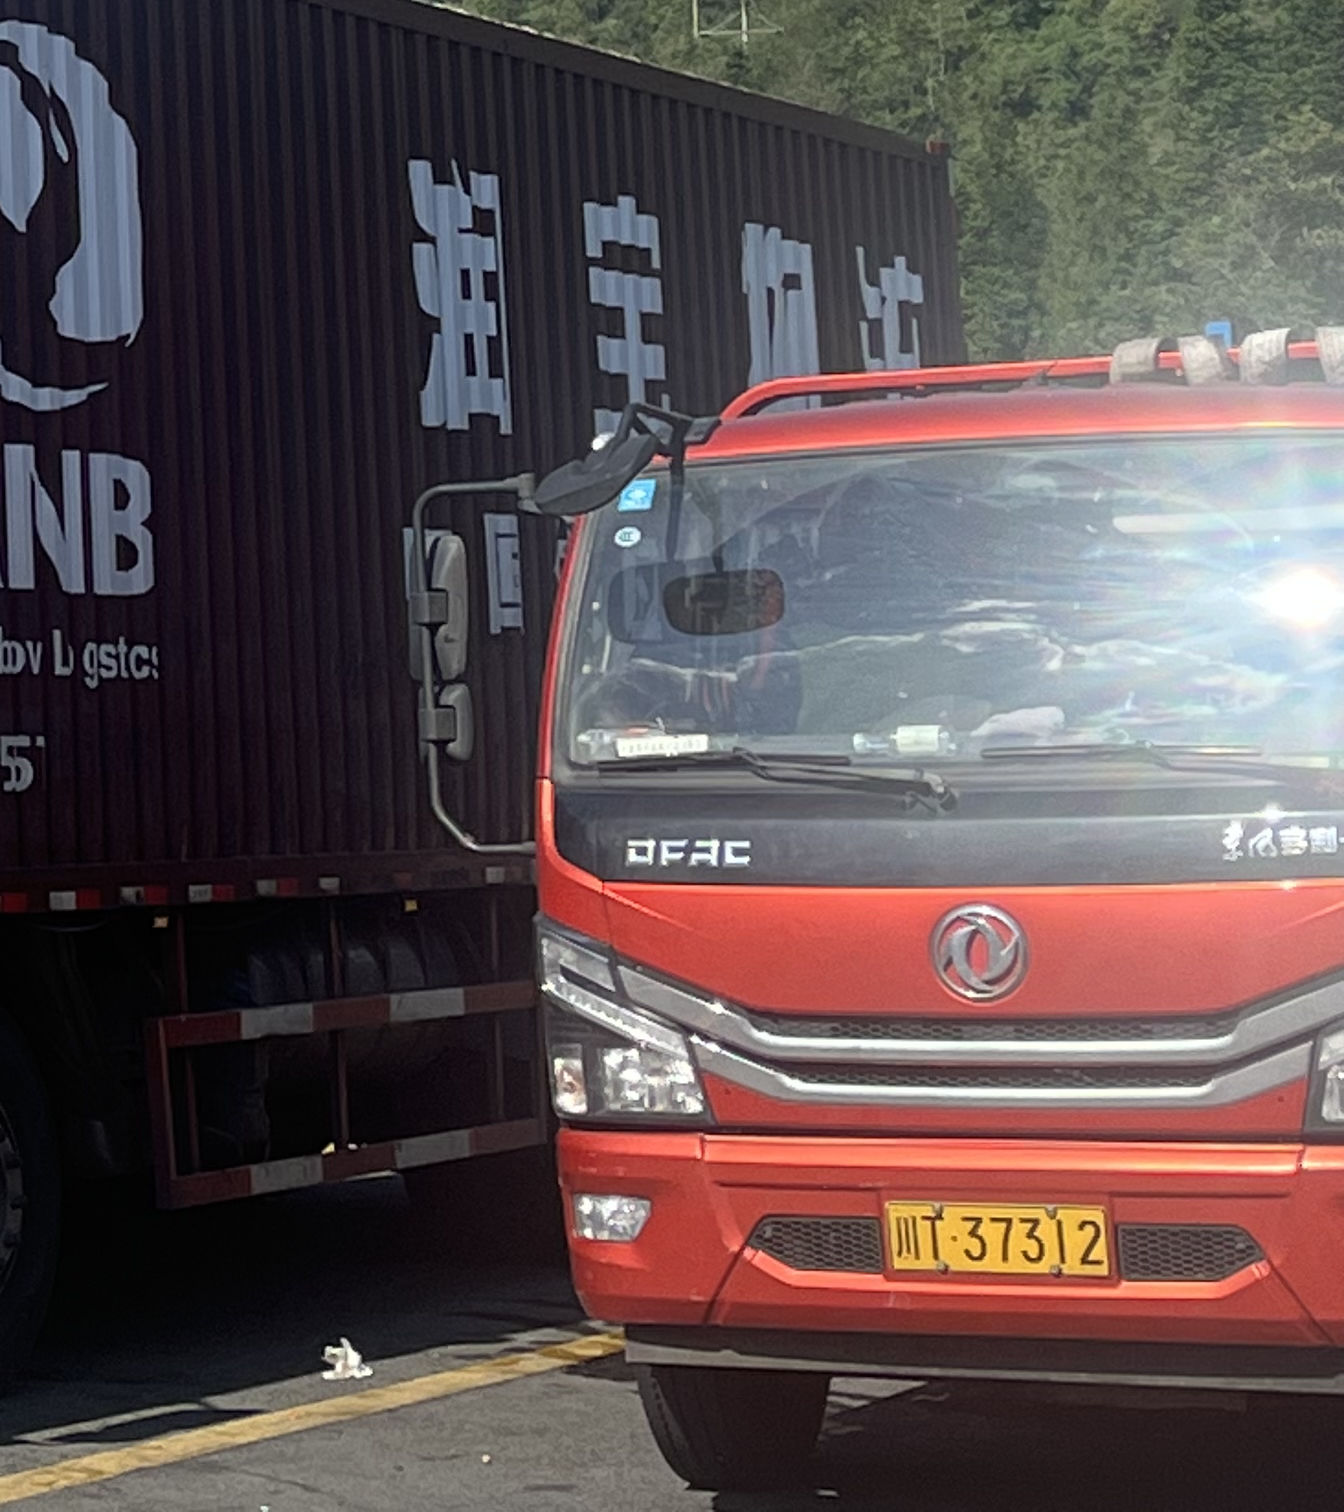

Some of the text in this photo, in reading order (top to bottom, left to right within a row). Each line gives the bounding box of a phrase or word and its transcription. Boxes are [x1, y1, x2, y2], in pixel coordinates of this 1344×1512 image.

[626, 838, 751, 866] DFAC
[1222, 819, 1344, 861] 东风多利
